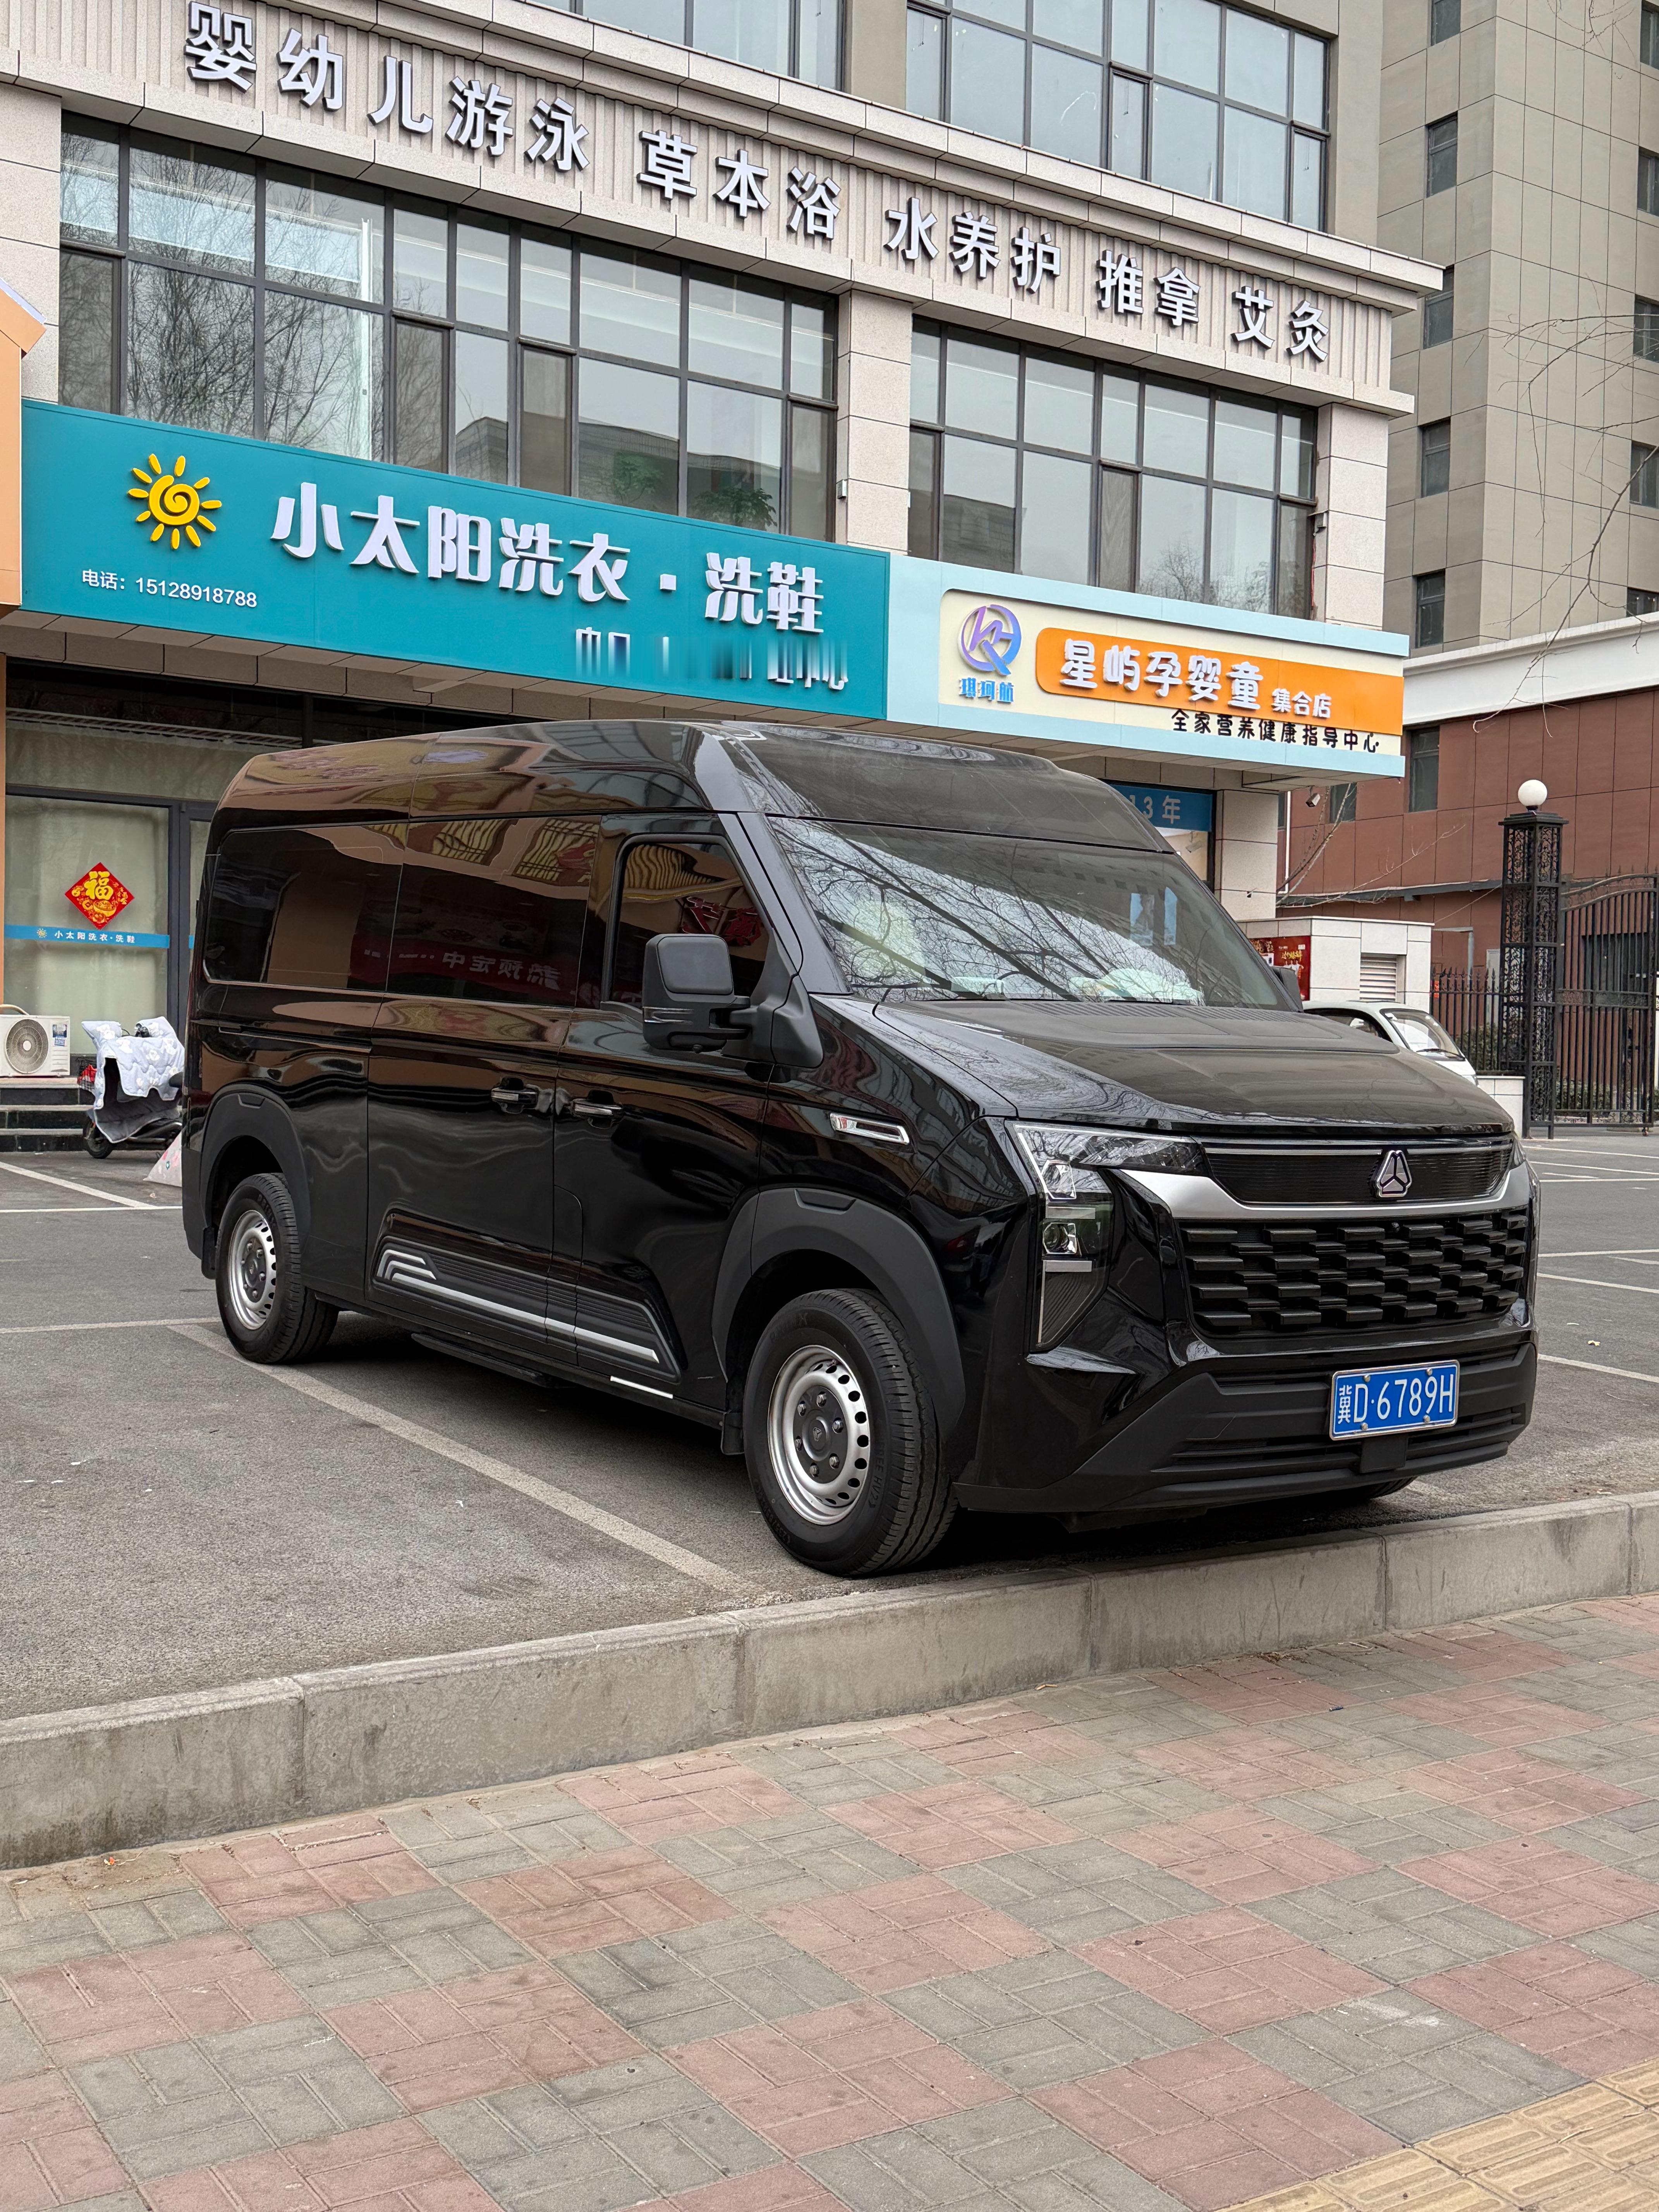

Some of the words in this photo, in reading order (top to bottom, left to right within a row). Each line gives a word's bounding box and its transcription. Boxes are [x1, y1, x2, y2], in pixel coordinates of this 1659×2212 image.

[184, 1, 590, 172] 婴幼儿游泳
[637, 129, 842, 241] 草本浴
[883, 196, 1061, 294] 水养护
[1097, 249, 1201, 327] 推拿
[1231, 285, 1329, 362] 艾灸
[136, 577, 258, 608] 15128918788
[1060, 638, 1263, 710] 星屿孕婴童
[1271, 688, 1332, 719] 集合店
[1171, 708, 1380, 754] 全家营养健康指导中心
[84, 871, 114, 900] 福
